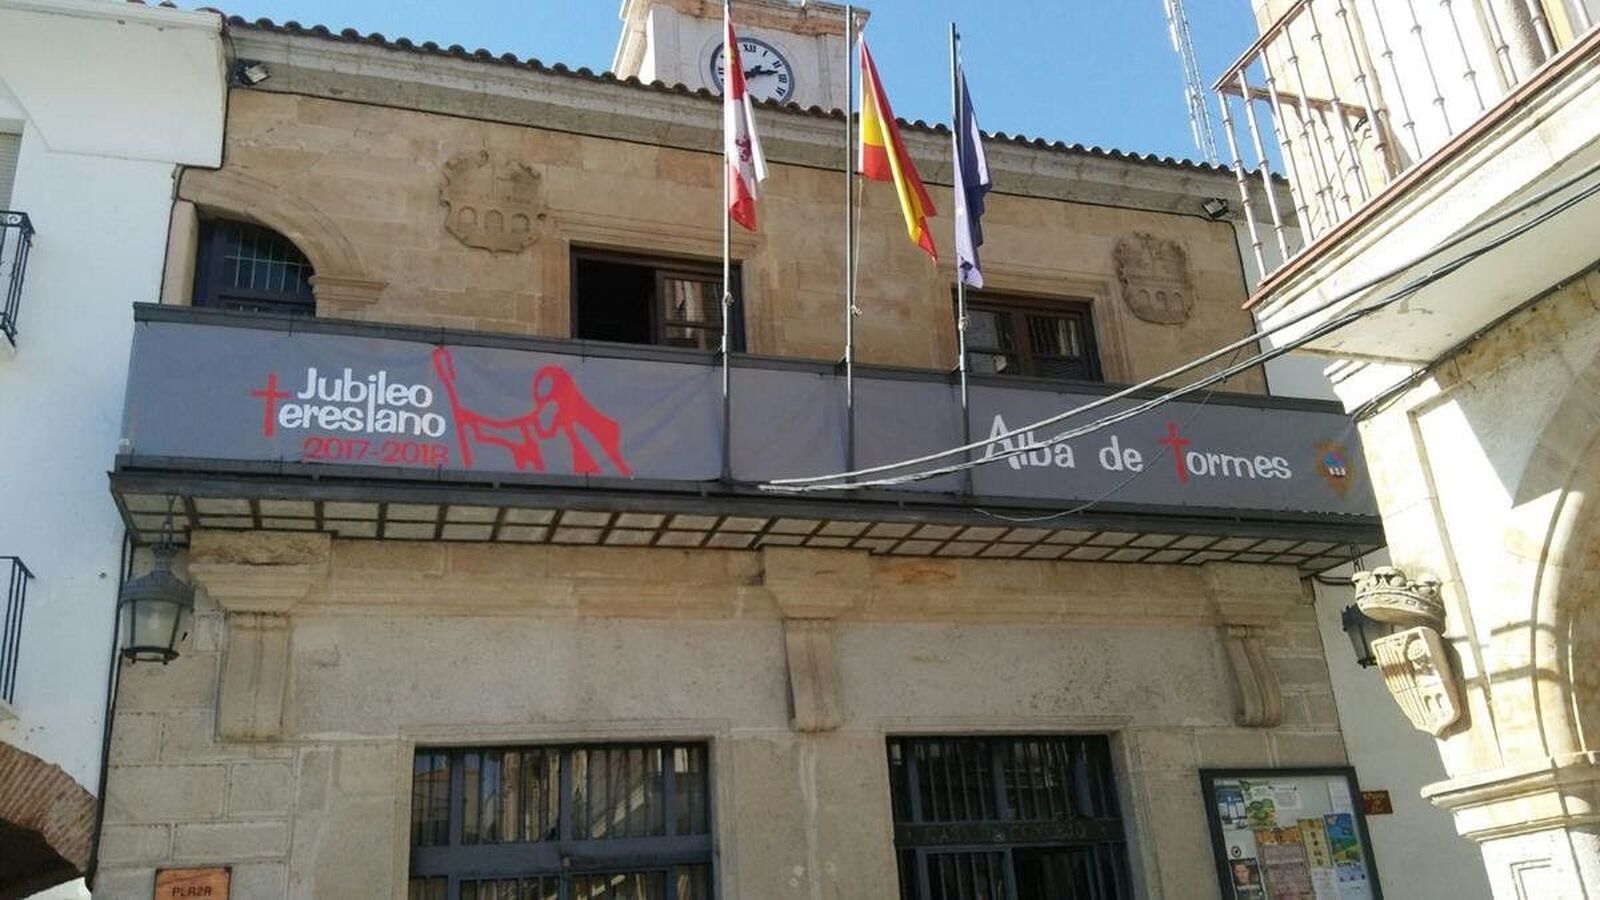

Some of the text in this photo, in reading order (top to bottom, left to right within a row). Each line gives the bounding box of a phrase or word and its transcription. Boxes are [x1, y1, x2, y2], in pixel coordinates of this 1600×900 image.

[297, 367, 433, 408] Jubileo
[302, 436, 450, 467] 2017-2018
[983, 414, 1076, 470] Alba
[1098, 434, 1145, 472] de
[171, 886, 213, 897] PLAZA
